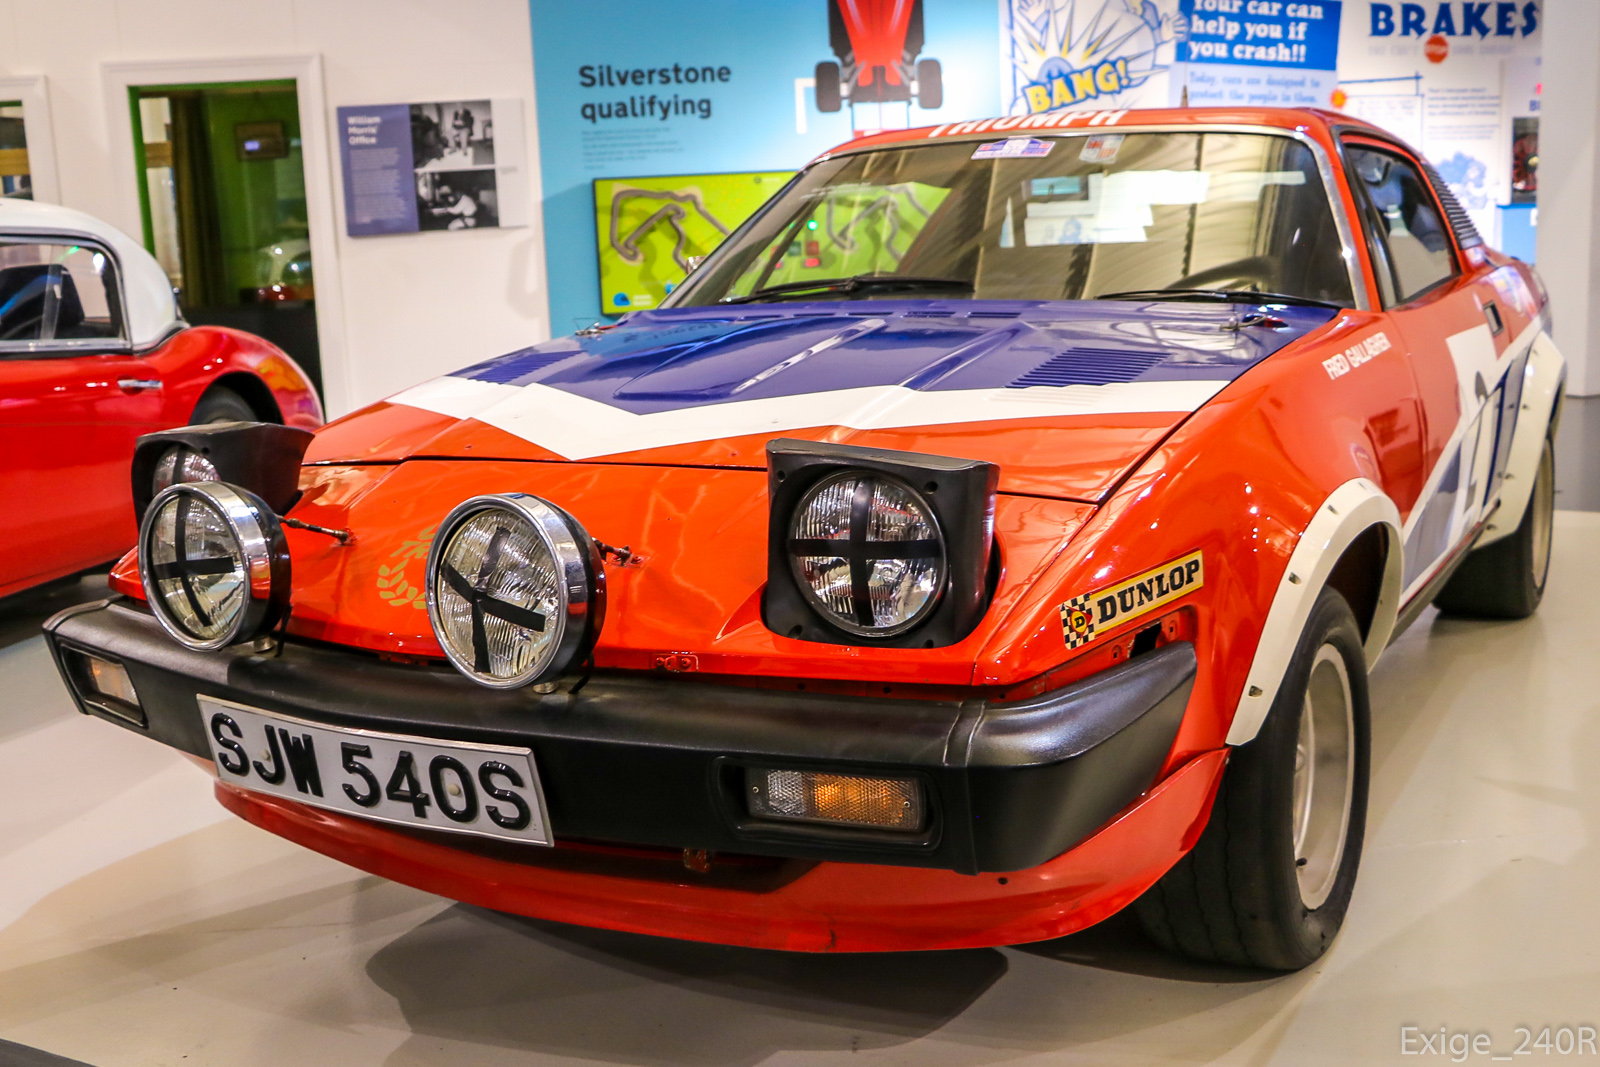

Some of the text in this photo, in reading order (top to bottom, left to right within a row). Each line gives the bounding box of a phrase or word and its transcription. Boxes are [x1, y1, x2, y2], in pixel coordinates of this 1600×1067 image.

[1246, 0, 1282, 16] car
[1286, 3, 1323, 20] can
[1369, 2, 1540, 40] BRAKES
[1190, 14, 1308, 41] help you if
[1189, 41, 1307, 63] you crash!!
[578, 63, 732, 88] Silverstone
[1023, 58, 1130, 114] BANG!
[580, 94, 712, 124] qualifying
[349, 136, 377, 145] Office
[1074, 558, 1200, 629] D DUNLOP
[211, 712, 532, 831] SJW 540S
